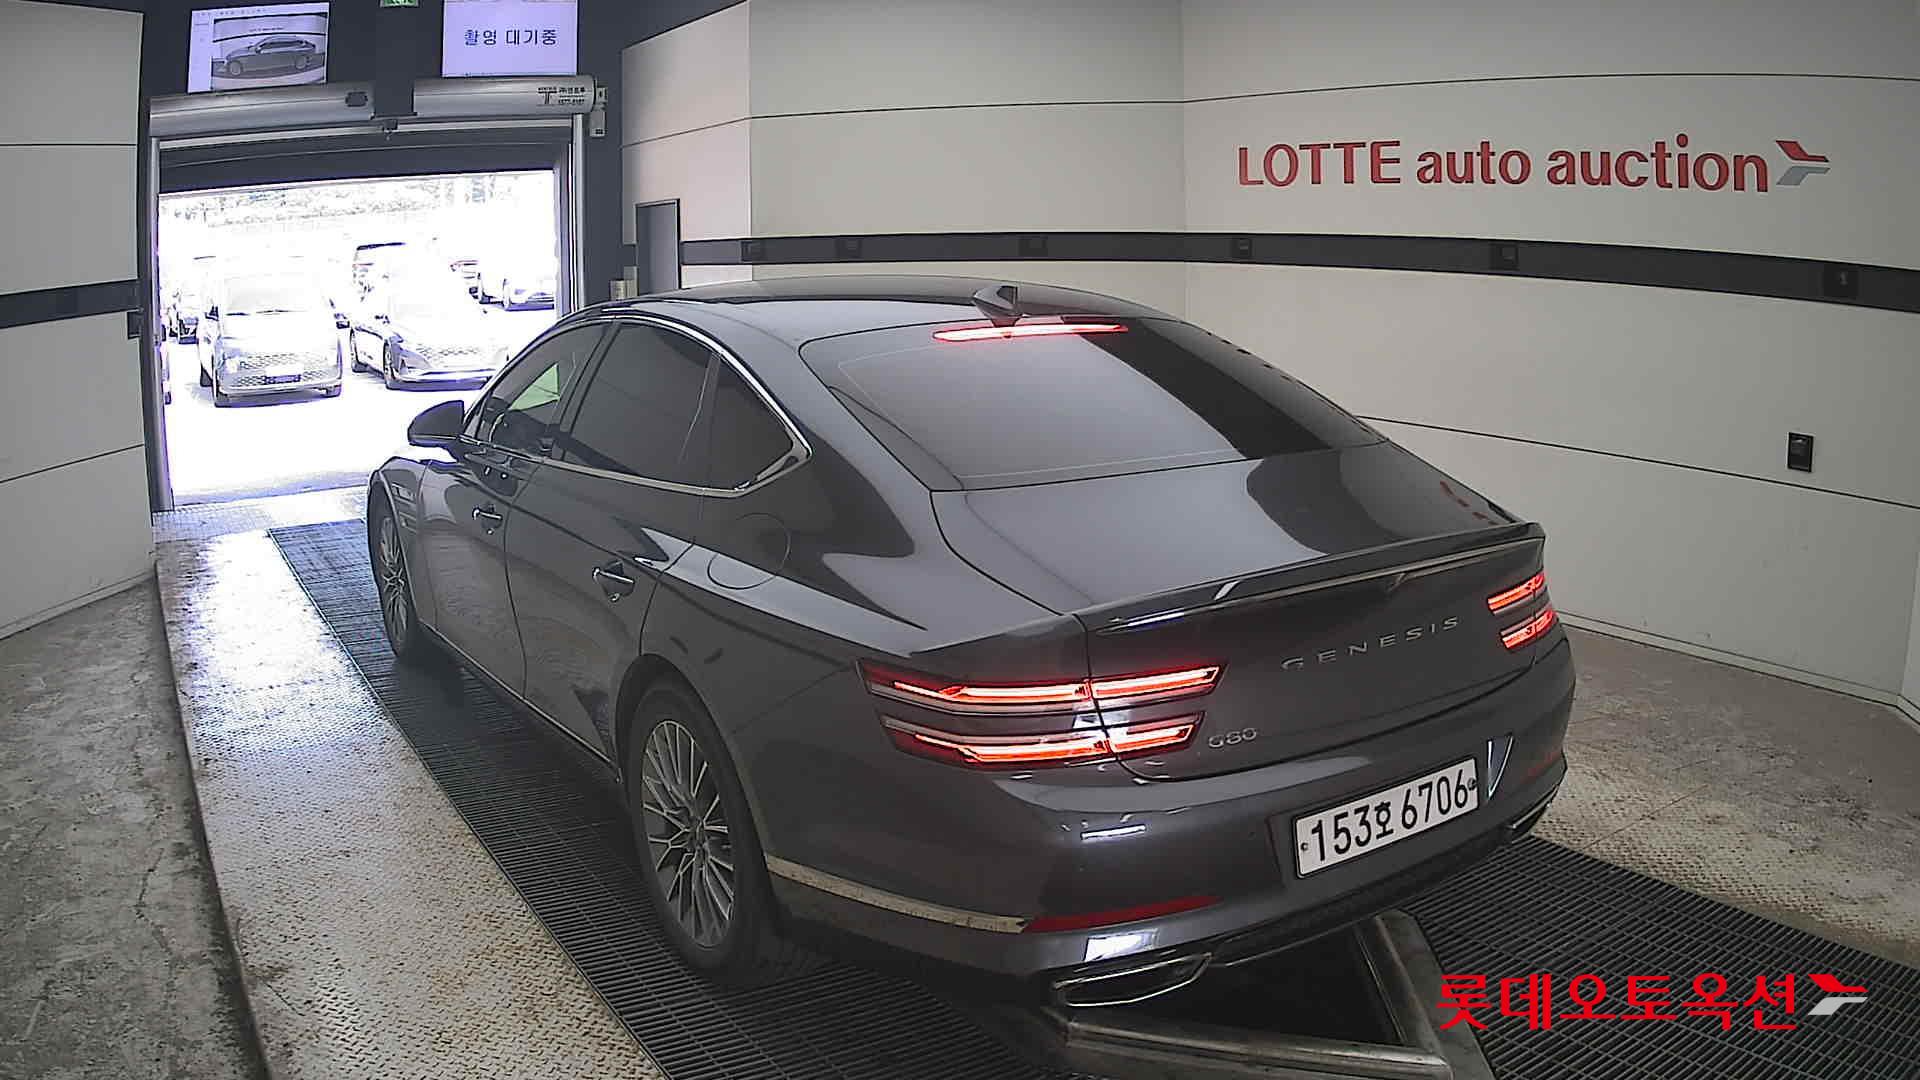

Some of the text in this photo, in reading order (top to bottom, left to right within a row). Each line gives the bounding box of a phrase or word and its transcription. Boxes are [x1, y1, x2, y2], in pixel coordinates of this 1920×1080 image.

[464, 29, 557, 46] 촬영 대기중
[1239, 133, 1769, 193] LOTTE auto auction
[1280, 616, 1458, 671] GENESIS
[1207, 727, 1258, 749] G80
[1311, 769, 1468, 862] 153호 6706
